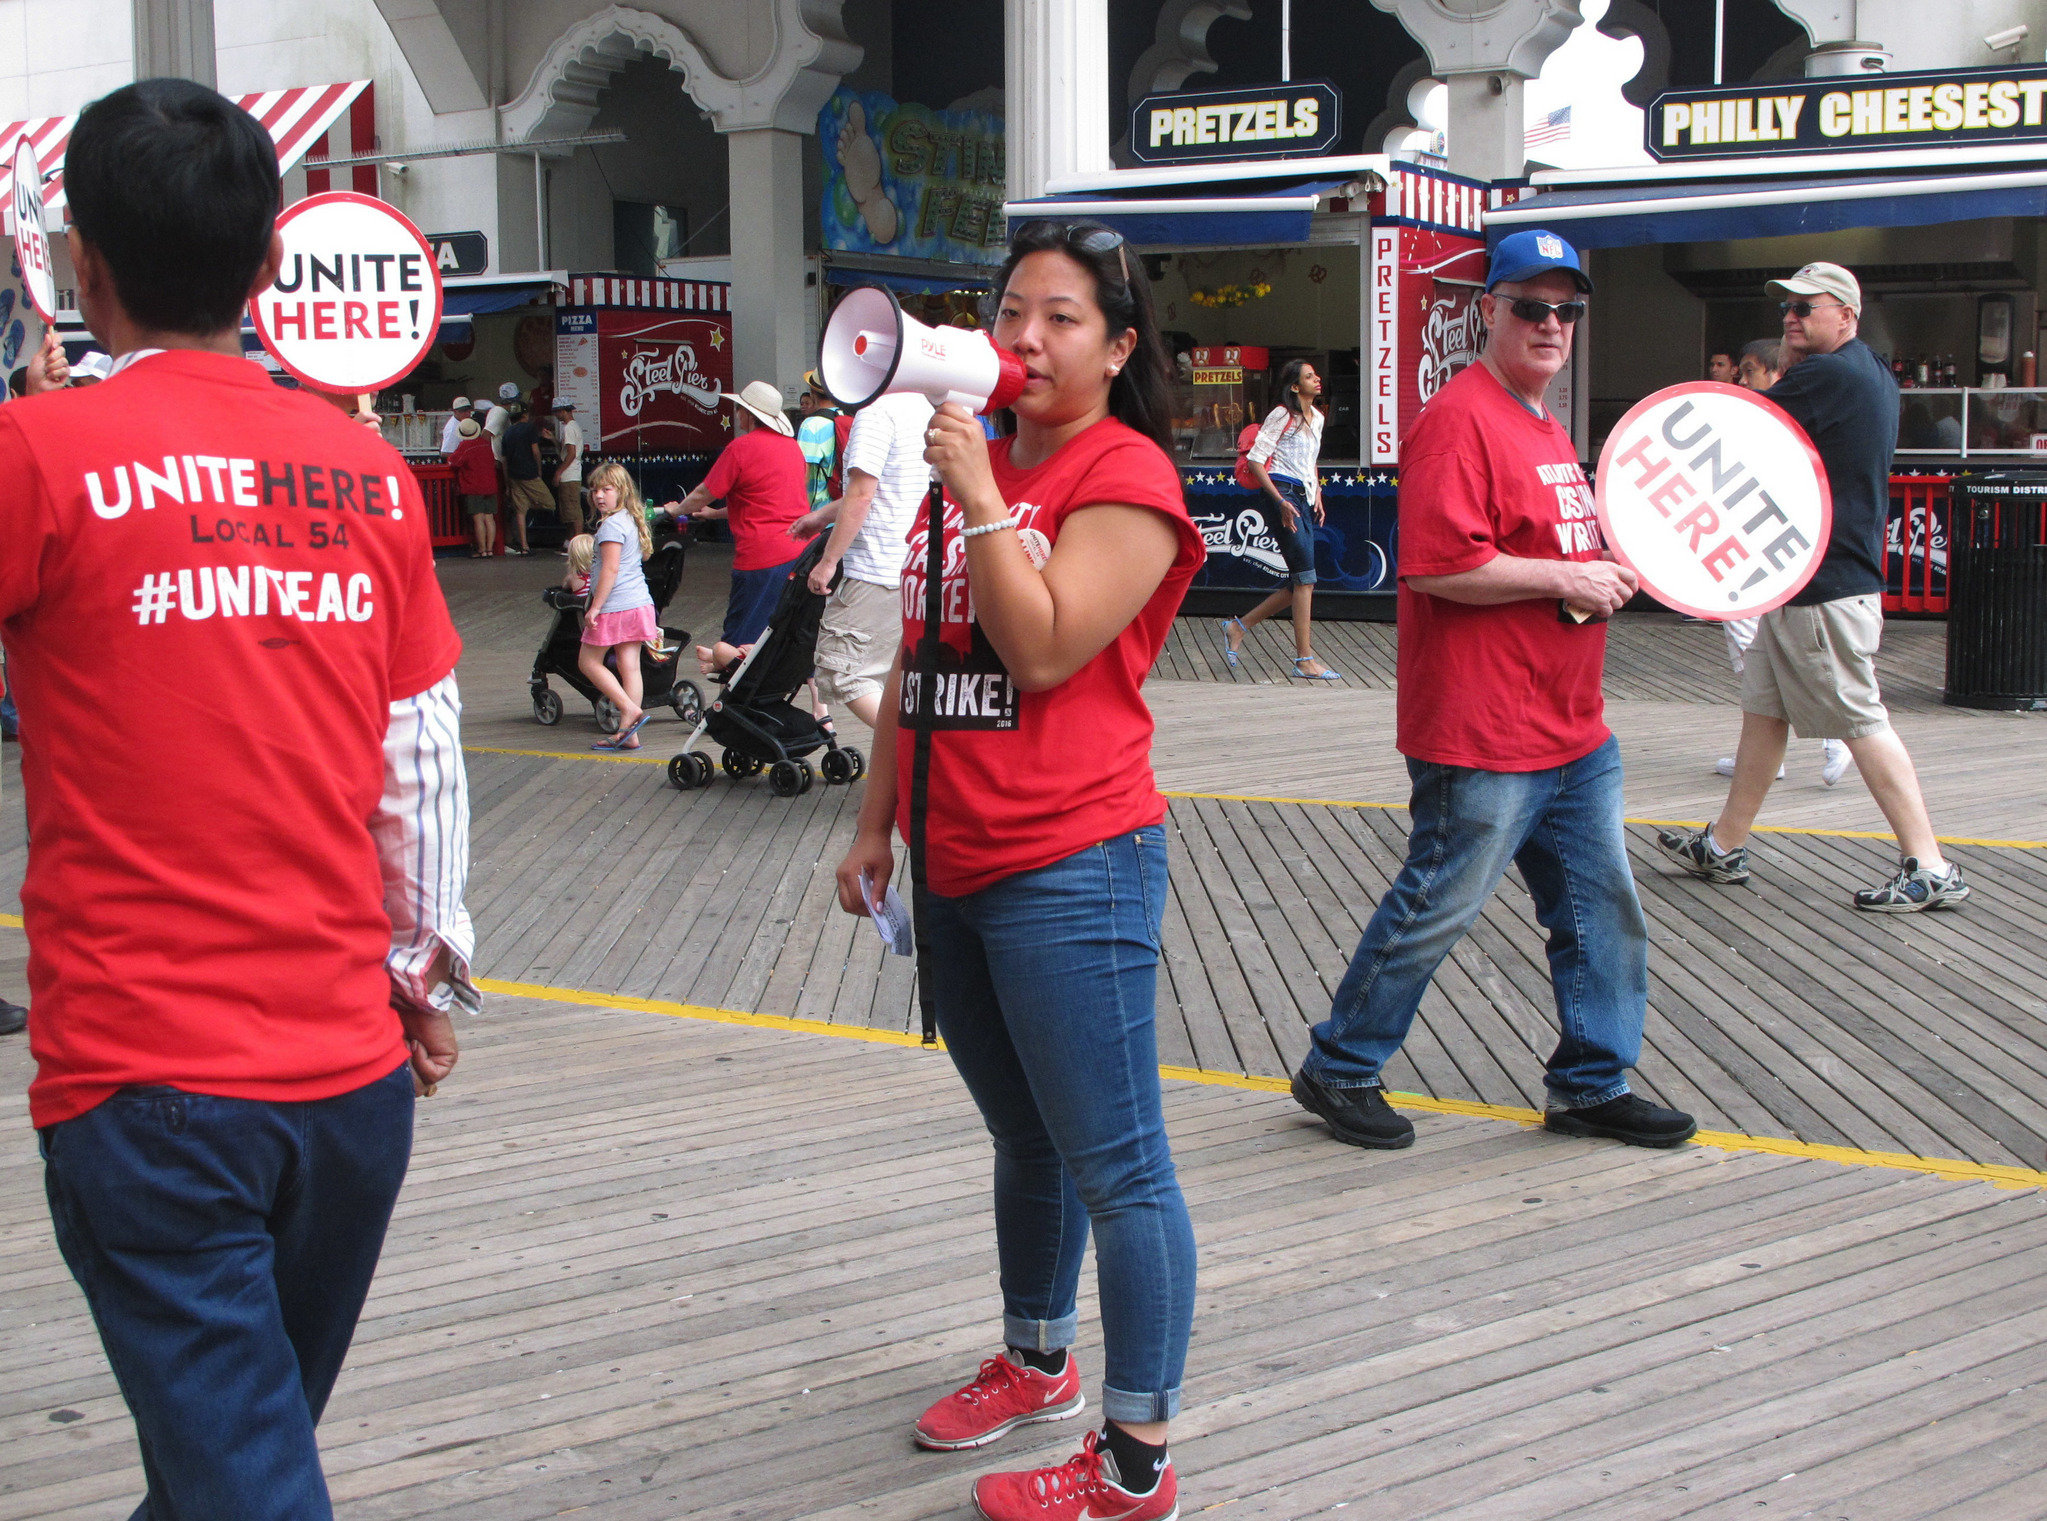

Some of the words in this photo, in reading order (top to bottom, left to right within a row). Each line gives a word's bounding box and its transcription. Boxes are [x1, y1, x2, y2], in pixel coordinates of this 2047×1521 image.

[1150, 98, 1319, 147] PRETZELS
[1663, 95, 1806, 147] PHILLY
[1818, 79, 2047, 138] CHEESEST
[273, 253, 422, 293] UNITE
[429, 242, 460, 269] A
[273, 299, 420, 340] HERE!
[561, 315, 593, 325] PIZZA
[1377, 238, 1392, 453] PRETZELS
[1418, 294, 1469, 404] Steel
[620, 347, 673, 417] Steel
[671, 345, 708, 394] Pier
[1194, 371, 1242, 384] PRETZELS
[84, 455, 403, 520] UNITEHERE!
[1661, 400, 1811, 573] UNITE
[1966, 485, 2009, 494] TOURISM
[190, 515, 294, 549] LOCAL
[308, 521, 350, 549] 54
[1230, 509, 1281, 557] Pier
[1615, 435, 1769, 602] HERE!
[132, 565, 374, 625] #UNITEAC
